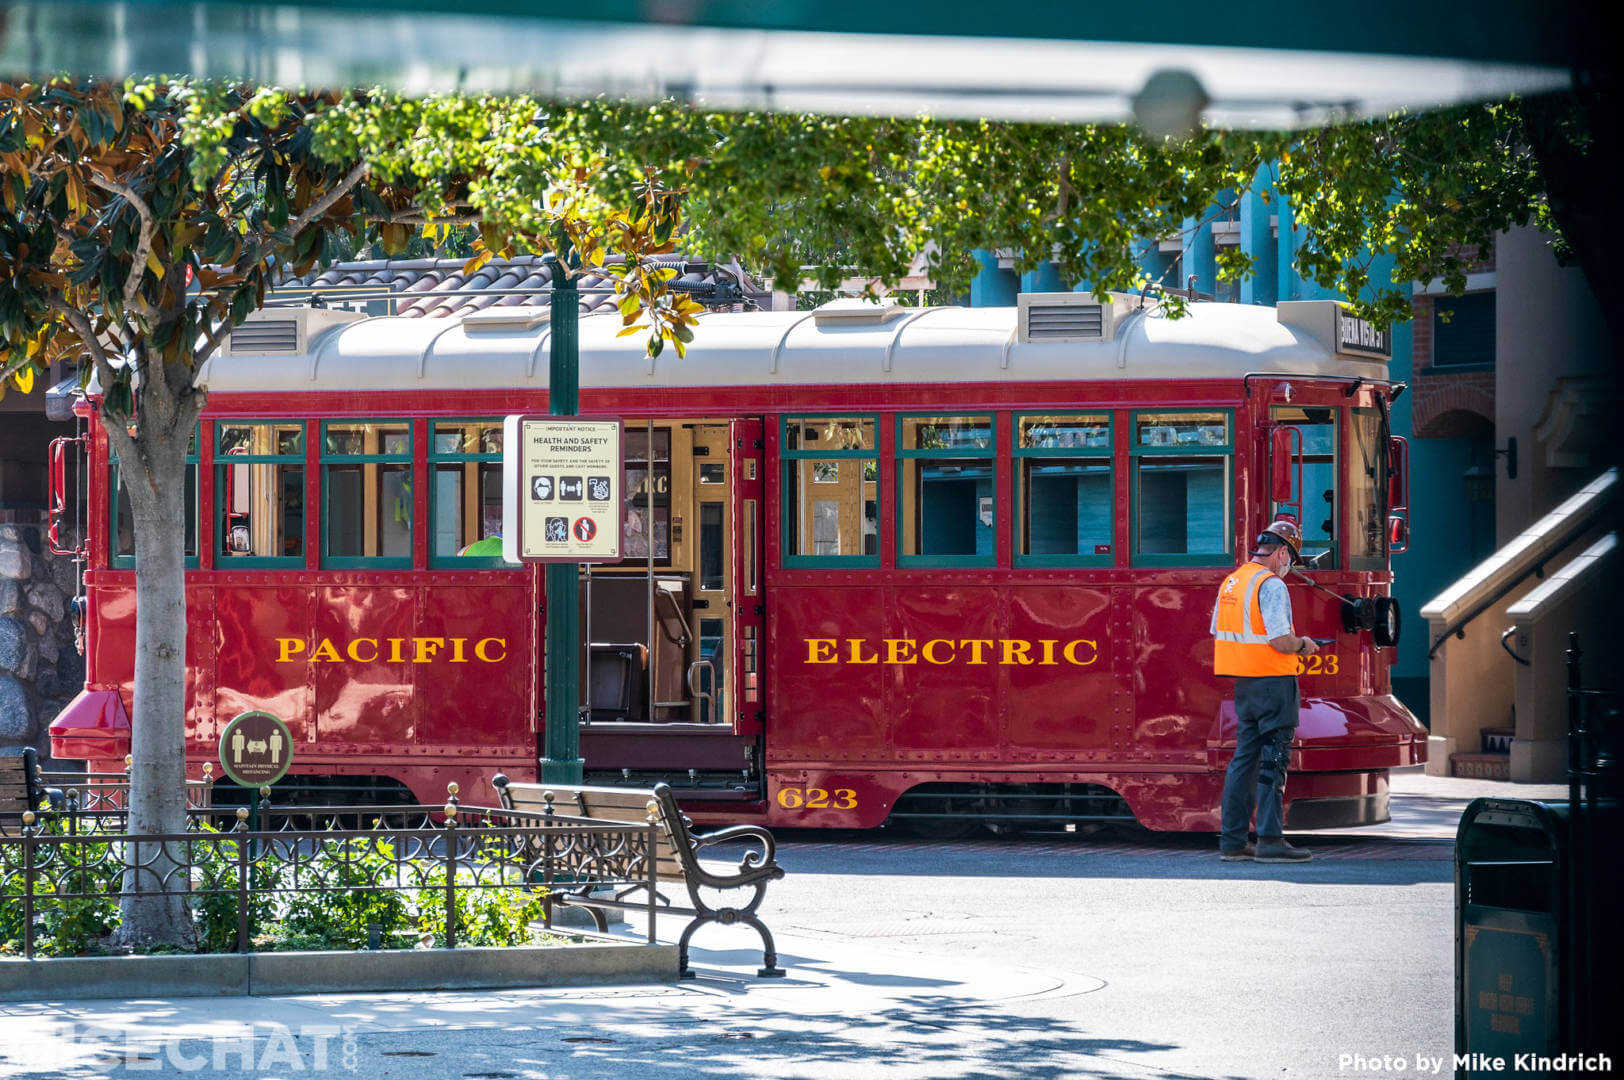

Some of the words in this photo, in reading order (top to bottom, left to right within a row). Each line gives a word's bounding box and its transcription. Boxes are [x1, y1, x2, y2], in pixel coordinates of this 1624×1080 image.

[563, 437, 579, 445] AND
[580, 437, 608, 445] SAFETY
[275, 637, 507, 663] PACIFIC
[803, 638, 1098, 665] ELECTRIC
[777, 787, 858, 809] 623
